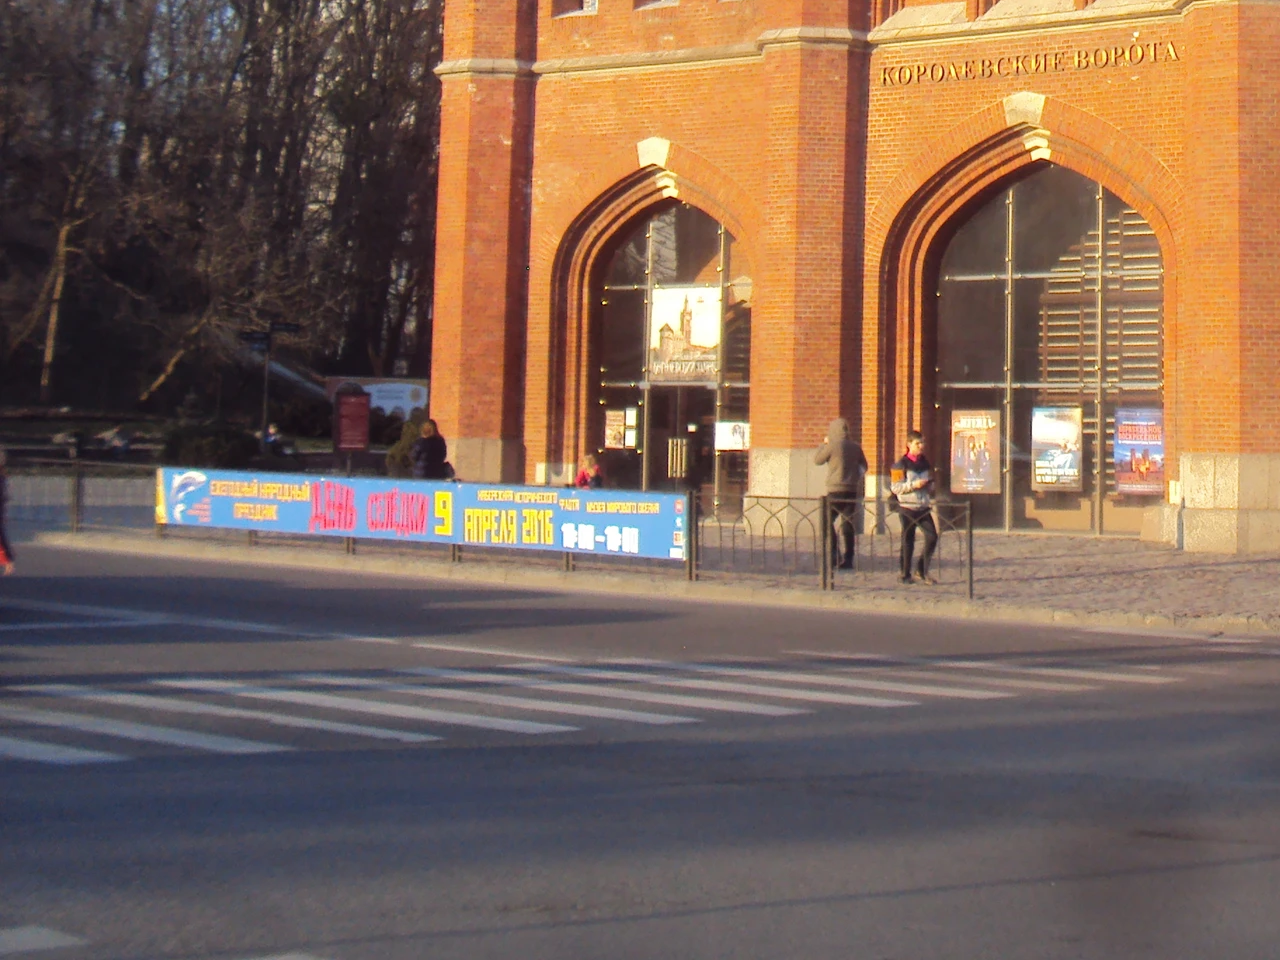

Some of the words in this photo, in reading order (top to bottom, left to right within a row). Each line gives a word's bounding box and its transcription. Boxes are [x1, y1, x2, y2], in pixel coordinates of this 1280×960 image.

[880, 52, 1066, 87] КОРОЛЕВСКИЕ
[1073, 40, 1180, 71] ВОРОТА
[260, 482, 309, 501] НАРОДНЫЙ
[308, 482, 356, 533] ДЕНЬ
[368, 488, 429, 536] СЕЛЁДКИ
[434, 490, 453, 536] 9
[465, 509, 516, 544] АПРЕЛЯ
[521, 509, 554, 545] 2016
